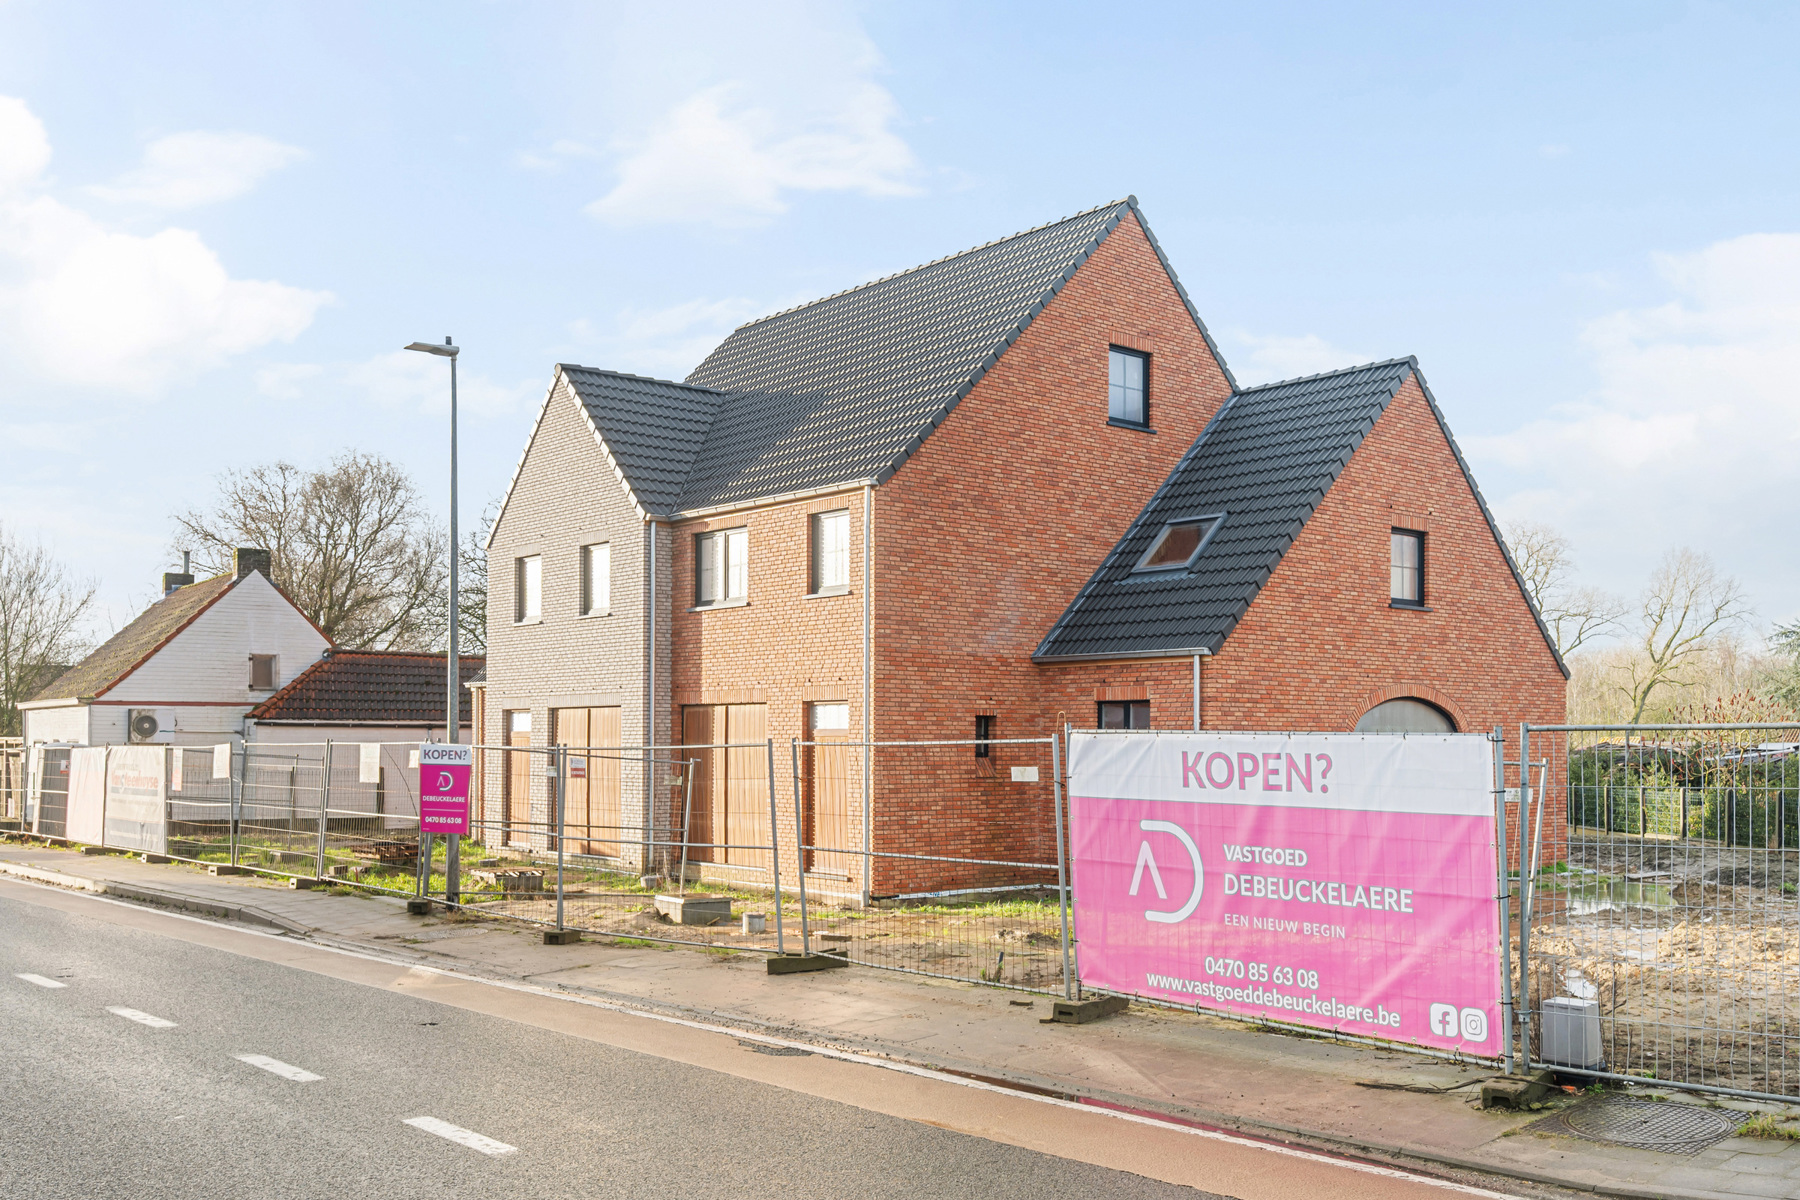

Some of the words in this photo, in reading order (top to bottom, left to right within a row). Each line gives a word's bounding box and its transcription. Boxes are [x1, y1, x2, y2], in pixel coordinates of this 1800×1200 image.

[423, 749, 467, 760] KOPEN?
[1181, 751, 1333, 793] KOPEN?
[422, 795, 466, 803] DEBEUCKELAERE
[440, 816, 447, 824] 85
[1223, 844, 1308, 867] VASTGOED
[1224, 873, 1414, 914] DEBEUCKELAERE
[1224, 913, 1250, 928] EEN
[1253, 916, 1299, 934] NIEUW
[1303, 922, 1346, 939] BEGIN
[1204, 956, 1245, 979] 0470
[1248, 961, 1269, 982] 85
[1272, 964, 1293, 986] 63
[1297, 968, 1319, 990] 08
[1146, 972, 1400, 1027] www.vastgoeddebeuckelaere.be
